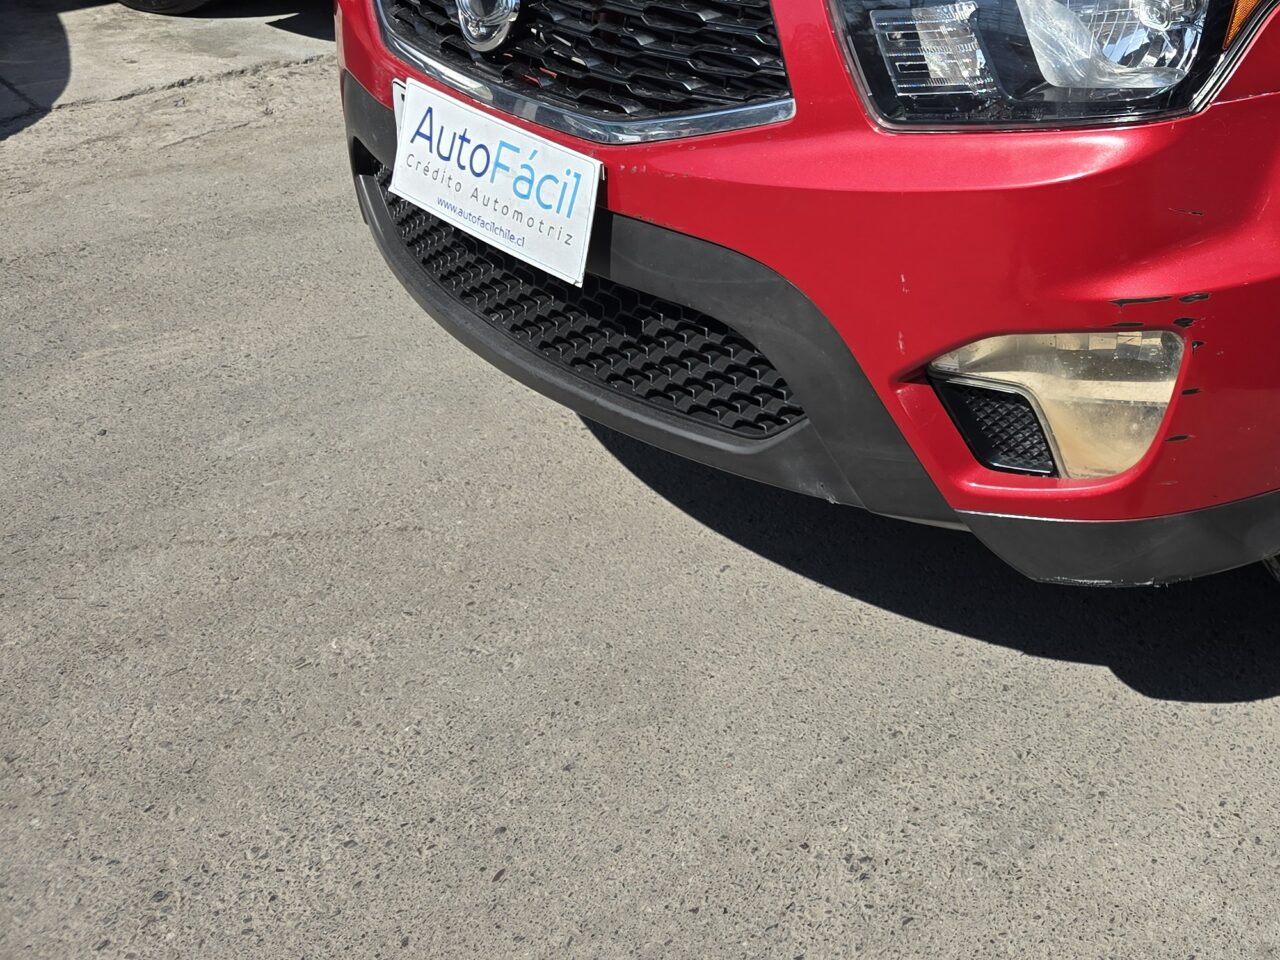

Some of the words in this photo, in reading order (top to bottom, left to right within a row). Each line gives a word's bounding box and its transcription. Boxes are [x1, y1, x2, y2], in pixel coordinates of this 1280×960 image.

[406, 153, 462, 192] Crédito
[470, 187, 574, 246] Automotriz
[410, 106, 582, 219] AutoFácil
[436, 196, 526, 248] www.autofacilchile.cl
